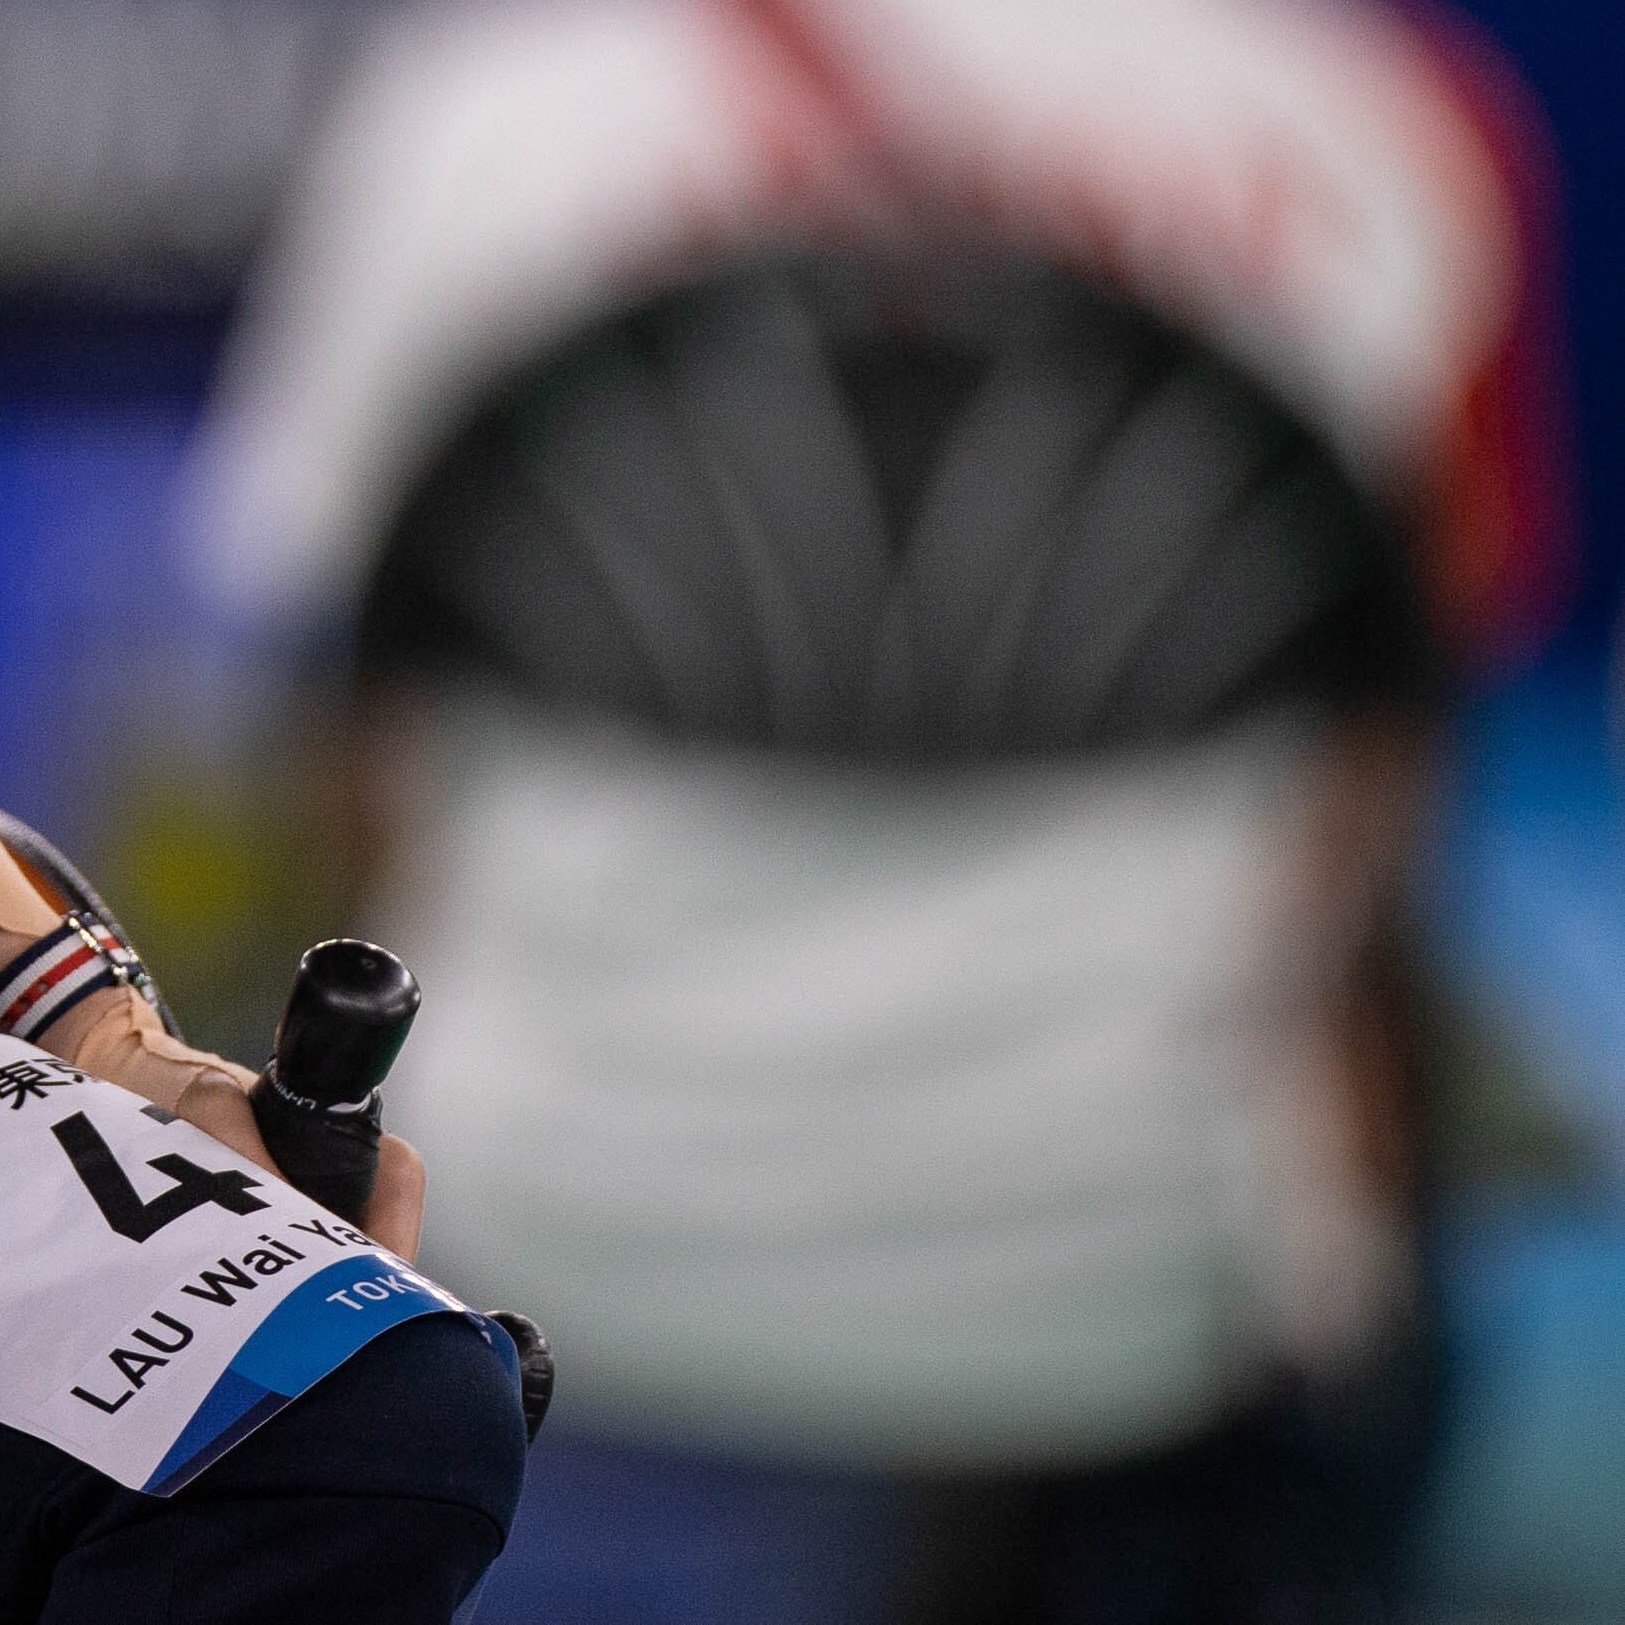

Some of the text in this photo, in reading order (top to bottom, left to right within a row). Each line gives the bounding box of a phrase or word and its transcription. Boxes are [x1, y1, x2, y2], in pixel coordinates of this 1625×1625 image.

[50, 1104, 272, 1243] 4
[70, 1219, 382, 1414] LAU Wai Ya
[326, 1274, 420, 1311] TOK
